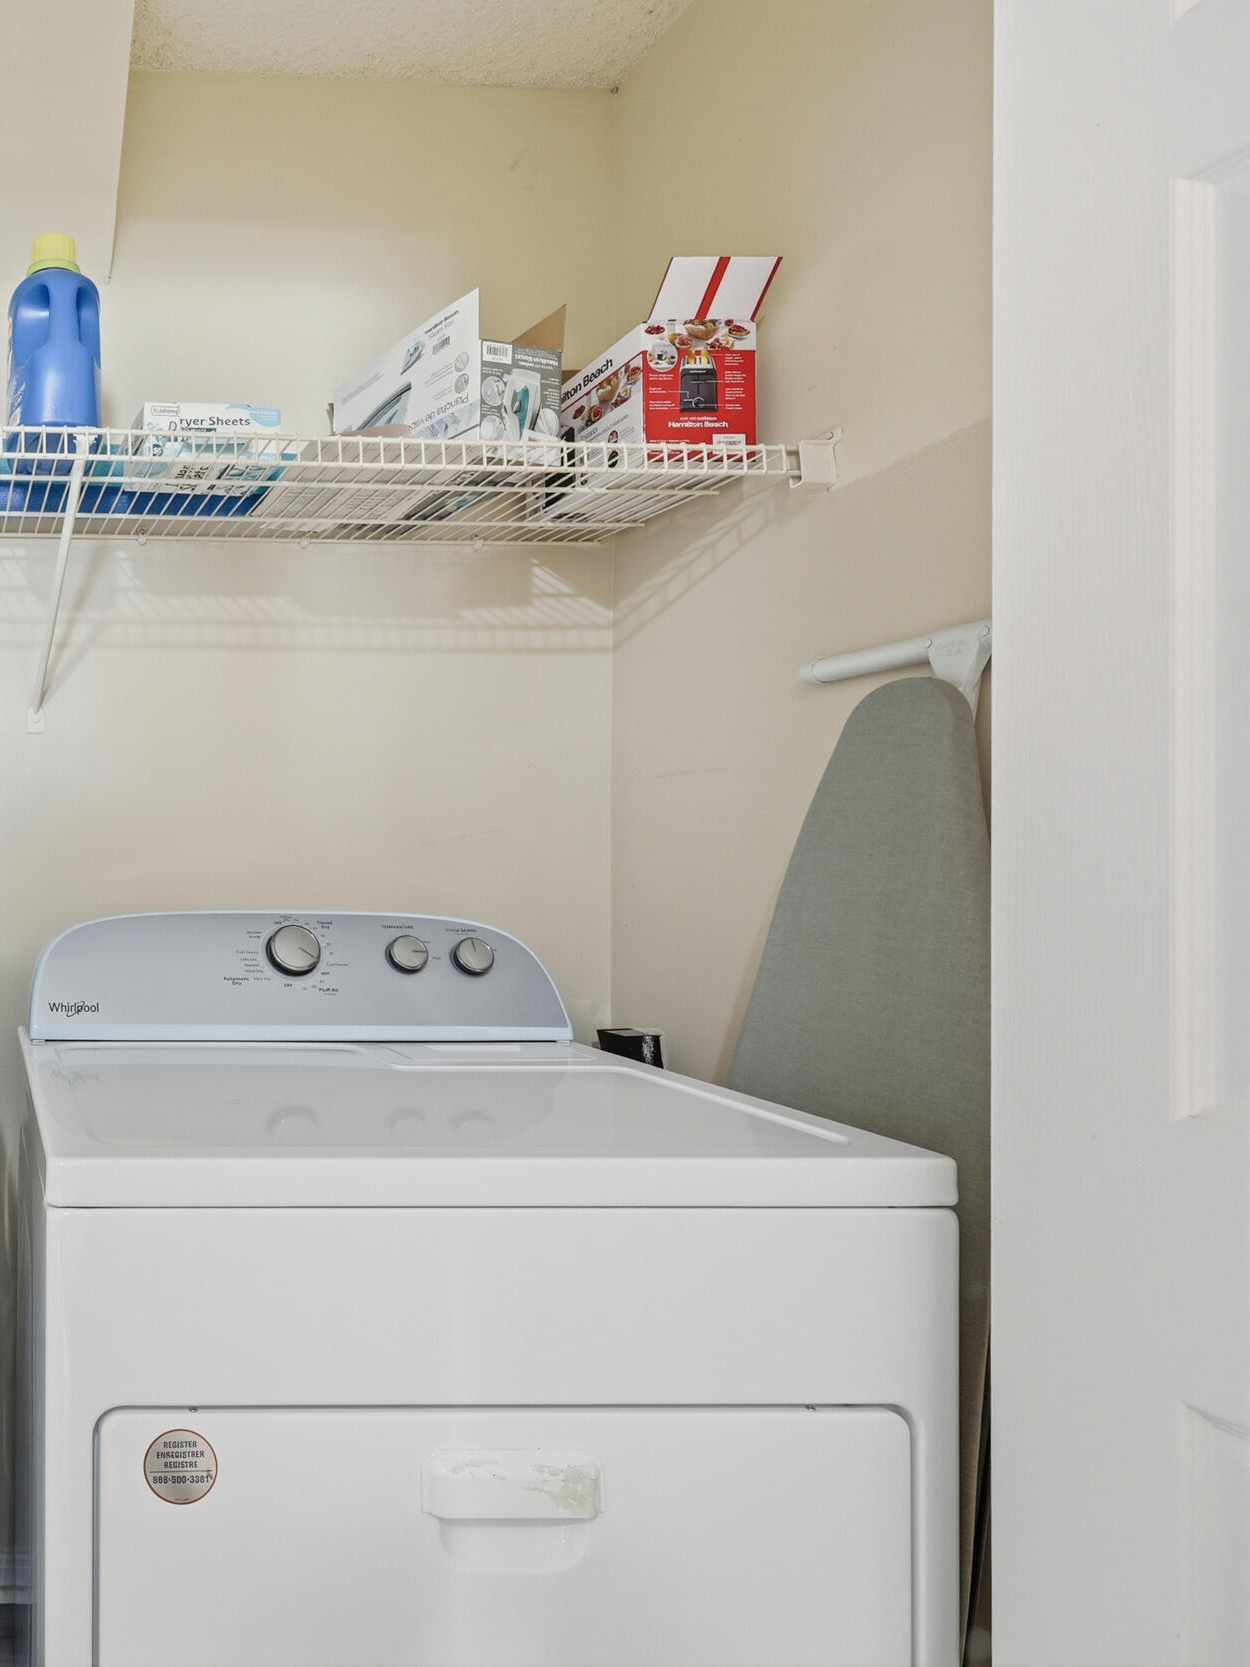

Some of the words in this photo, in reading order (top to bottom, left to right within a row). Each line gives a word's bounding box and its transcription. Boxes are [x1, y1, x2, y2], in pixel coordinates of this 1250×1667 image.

[560, 383, 583, 404] ilton
[582, 358, 613, 388] Beach
[208, 416, 251, 426] Sheets
[48, 1001, 100, 1017] Whirlpool
[163, 1440, 198, 1449] REGISTER
[163, 1461, 198, 1469] REGISTRE
